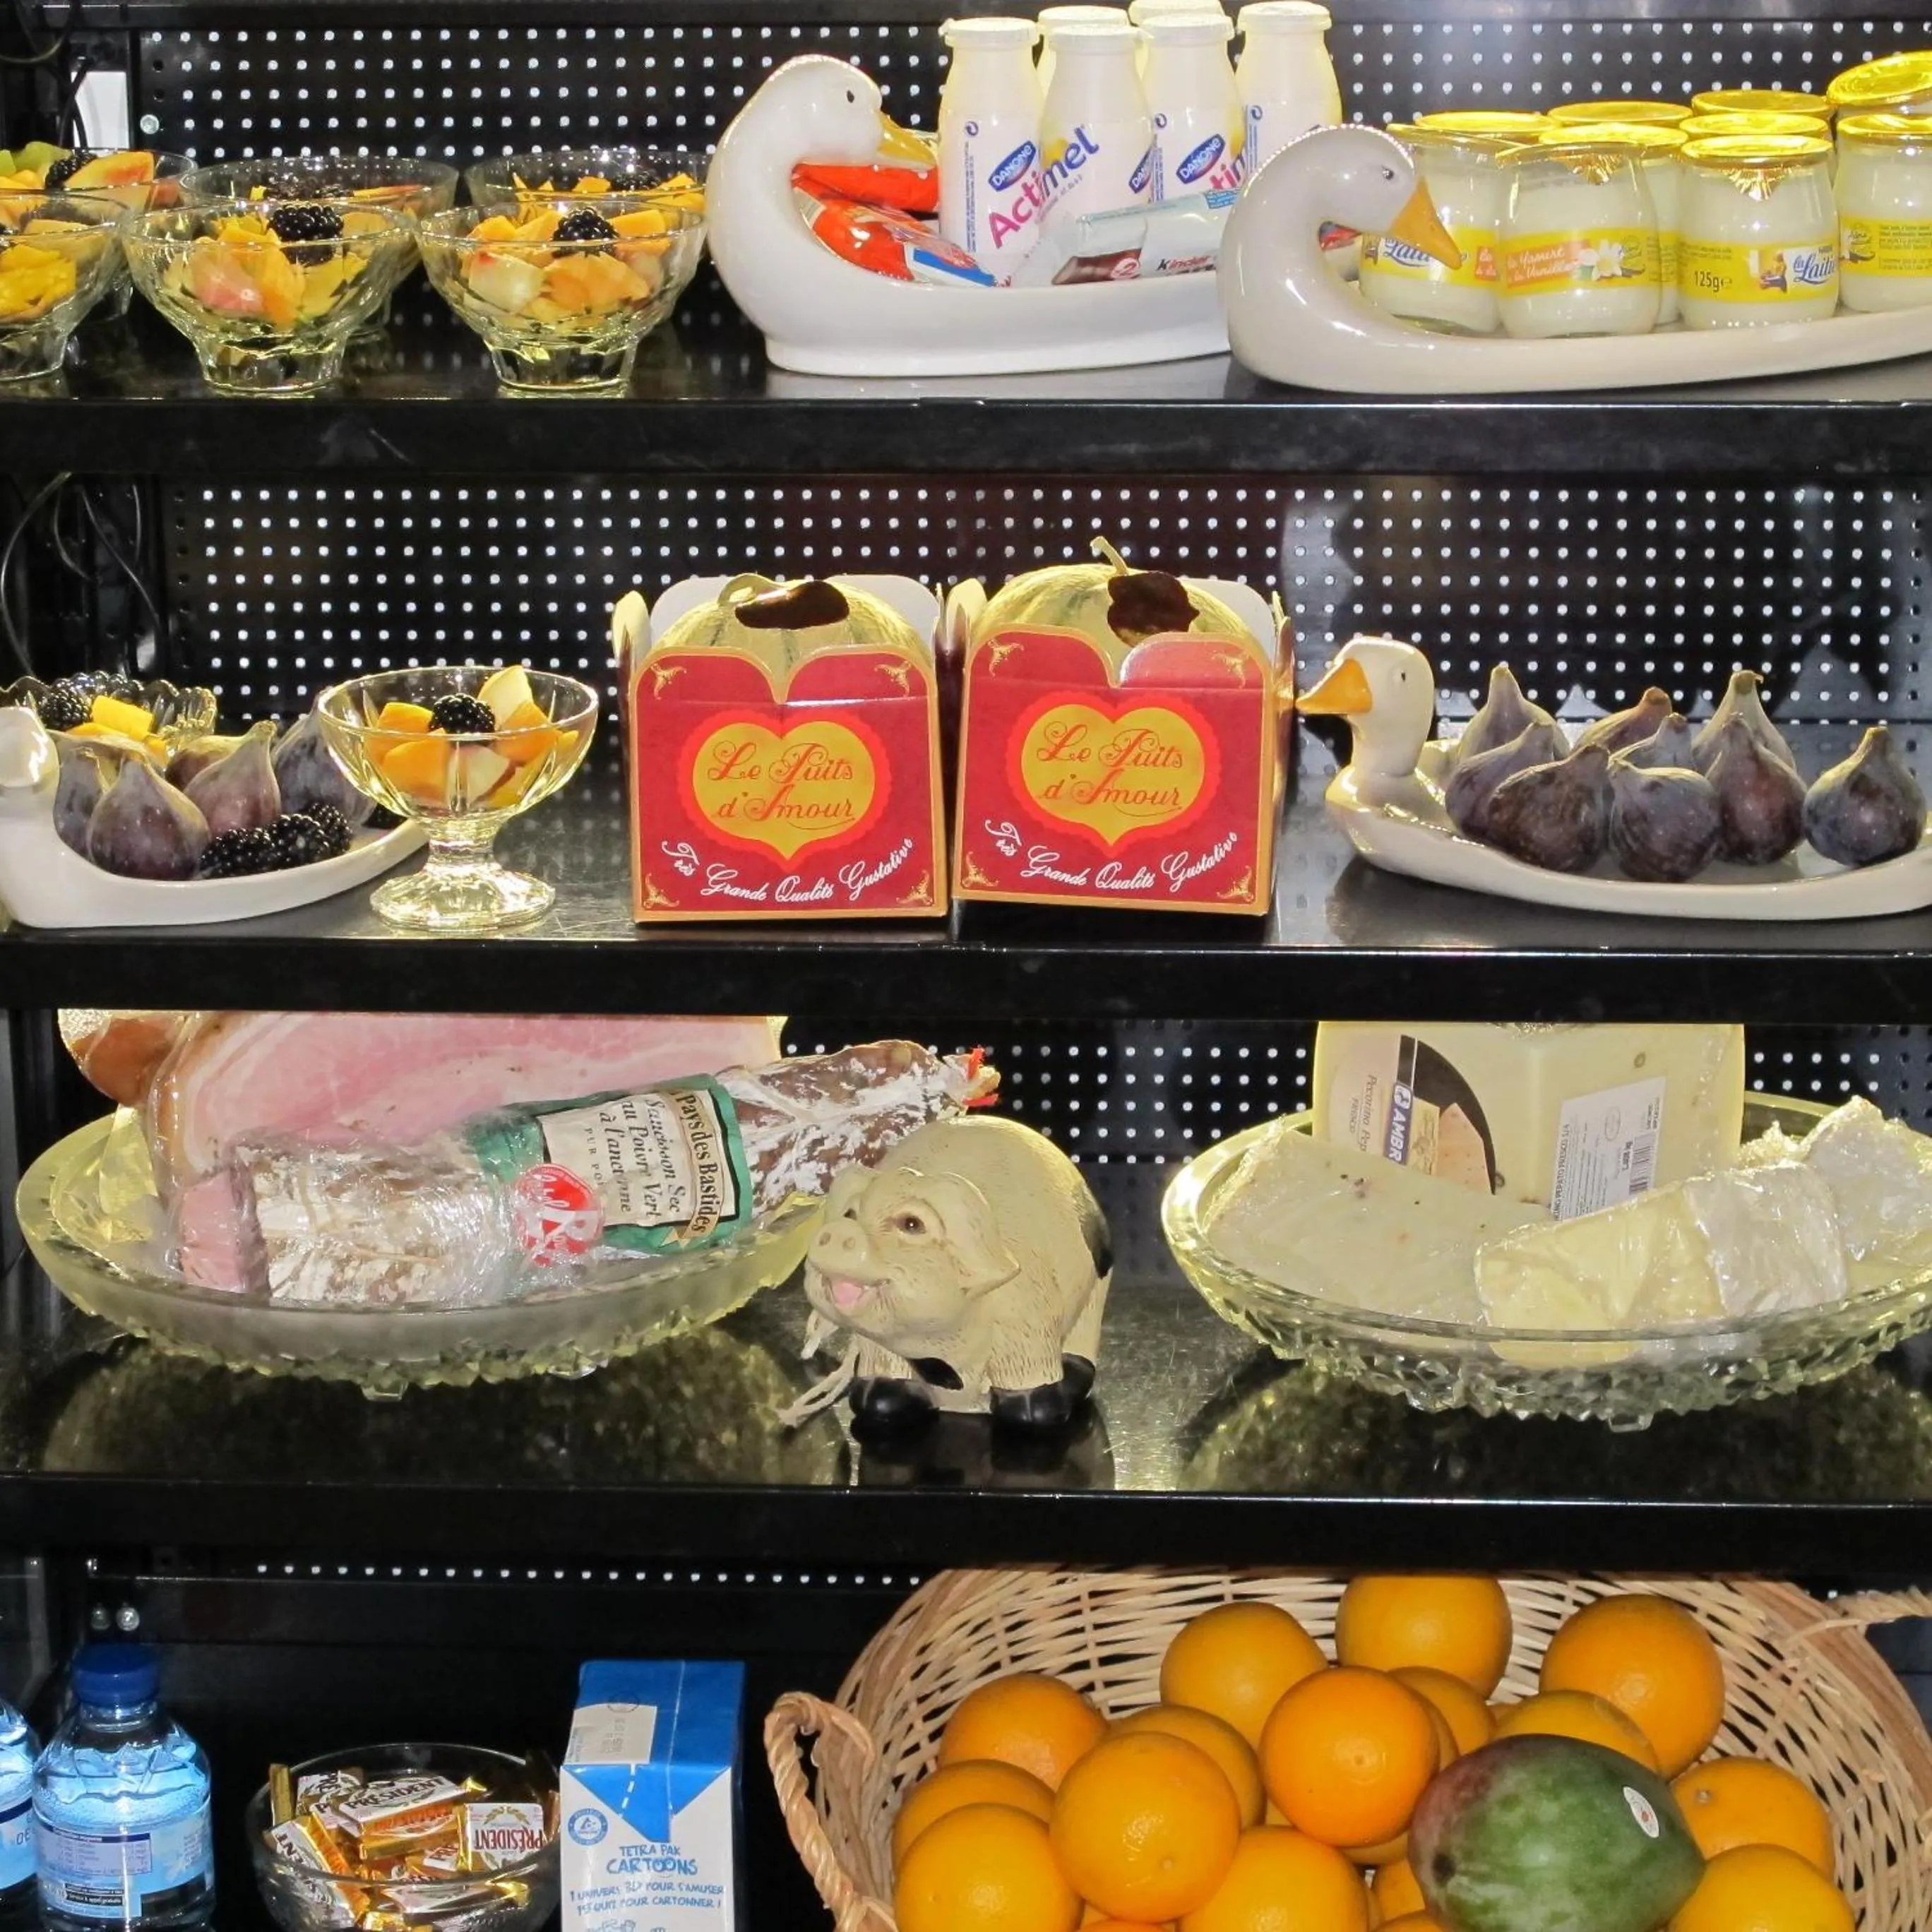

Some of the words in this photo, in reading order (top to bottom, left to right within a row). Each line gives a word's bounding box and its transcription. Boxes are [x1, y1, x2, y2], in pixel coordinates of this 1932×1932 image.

[991, 144, 1033, 186] DANONE
[1180, 137, 1222, 179] DANONE
[1695, 270, 1719, 292] 125g
[1037, 721, 1091, 762] Le
[708, 741, 762, 781] Le
[700, 864, 770, 902] Grande
[775, 876, 835, 903] Qualité
[839, 837, 914, 900] Gustative
[1020, 845, 1091, 886] Grande
[1095, 861, 1155, 890] Qualité
[1161, 831, 1238, 893] Gustative
[600, 1112, 616, 1123] à
[676, 1095, 703, 1128] Pays
[585, 1128, 597, 1155] PUR
[691, 1131, 712, 1160] des
[1360, 1130, 1371, 1152] Pep
[1388, 1108, 1407, 1162] AMBR
[643, 1183, 663, 1216] Vert
[668, 1184, 686, 1212] Sec
[691, 1164, 720, 1233] Bastides
[606, 1857, 698, 1875] CARTOONS
[619, 1844, 656, 1856] TETRA
[661, 1844, 681, 1856] PAK
